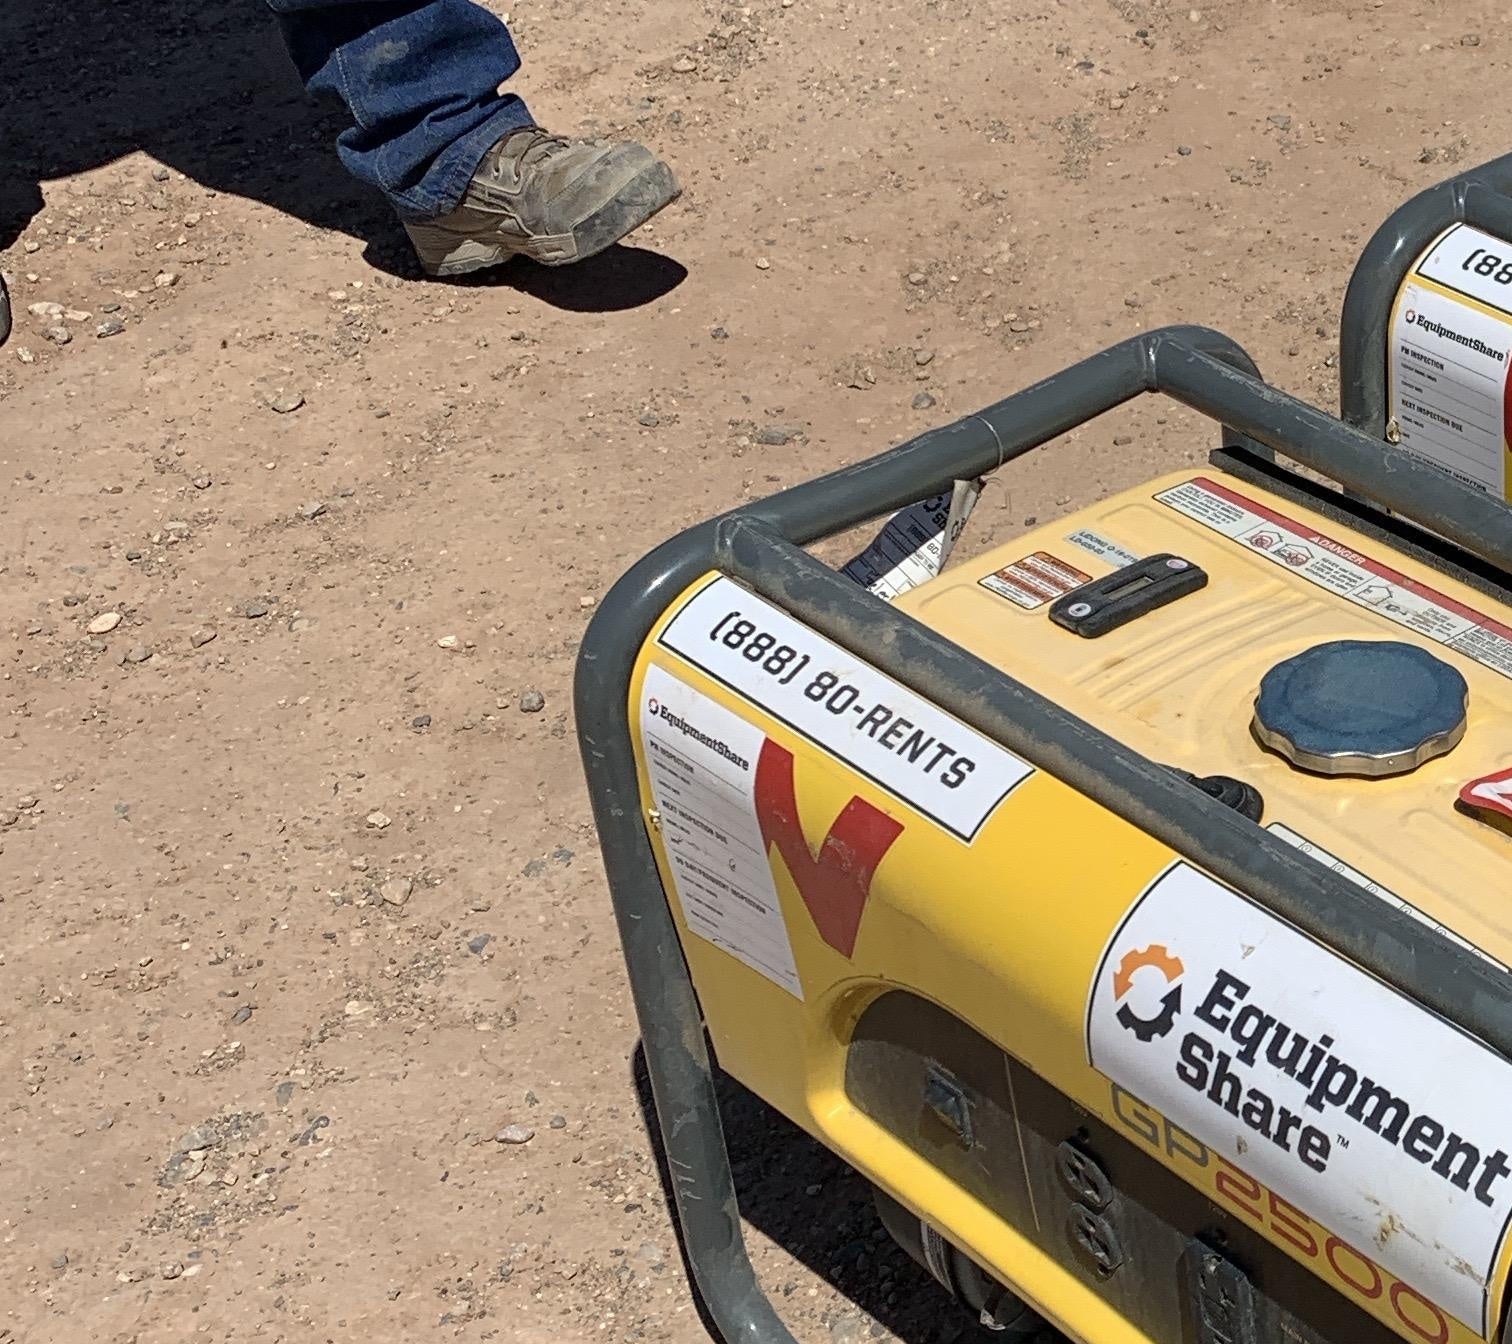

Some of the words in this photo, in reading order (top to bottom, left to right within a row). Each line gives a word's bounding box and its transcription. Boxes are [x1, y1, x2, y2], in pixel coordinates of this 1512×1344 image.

[1416, 313, 1505, 363] EquipmentShare
[1322, 539, 1366, 565] DANGER
[659, 704, 750, 772] EquipmentShare
[710, 611, 810, 685] (888)
[804, 670, 976, 790] 80-RENTS
[1175, 1032, 1332, 1175] Share
[1193, 969, 1512, 1206] Equipment
